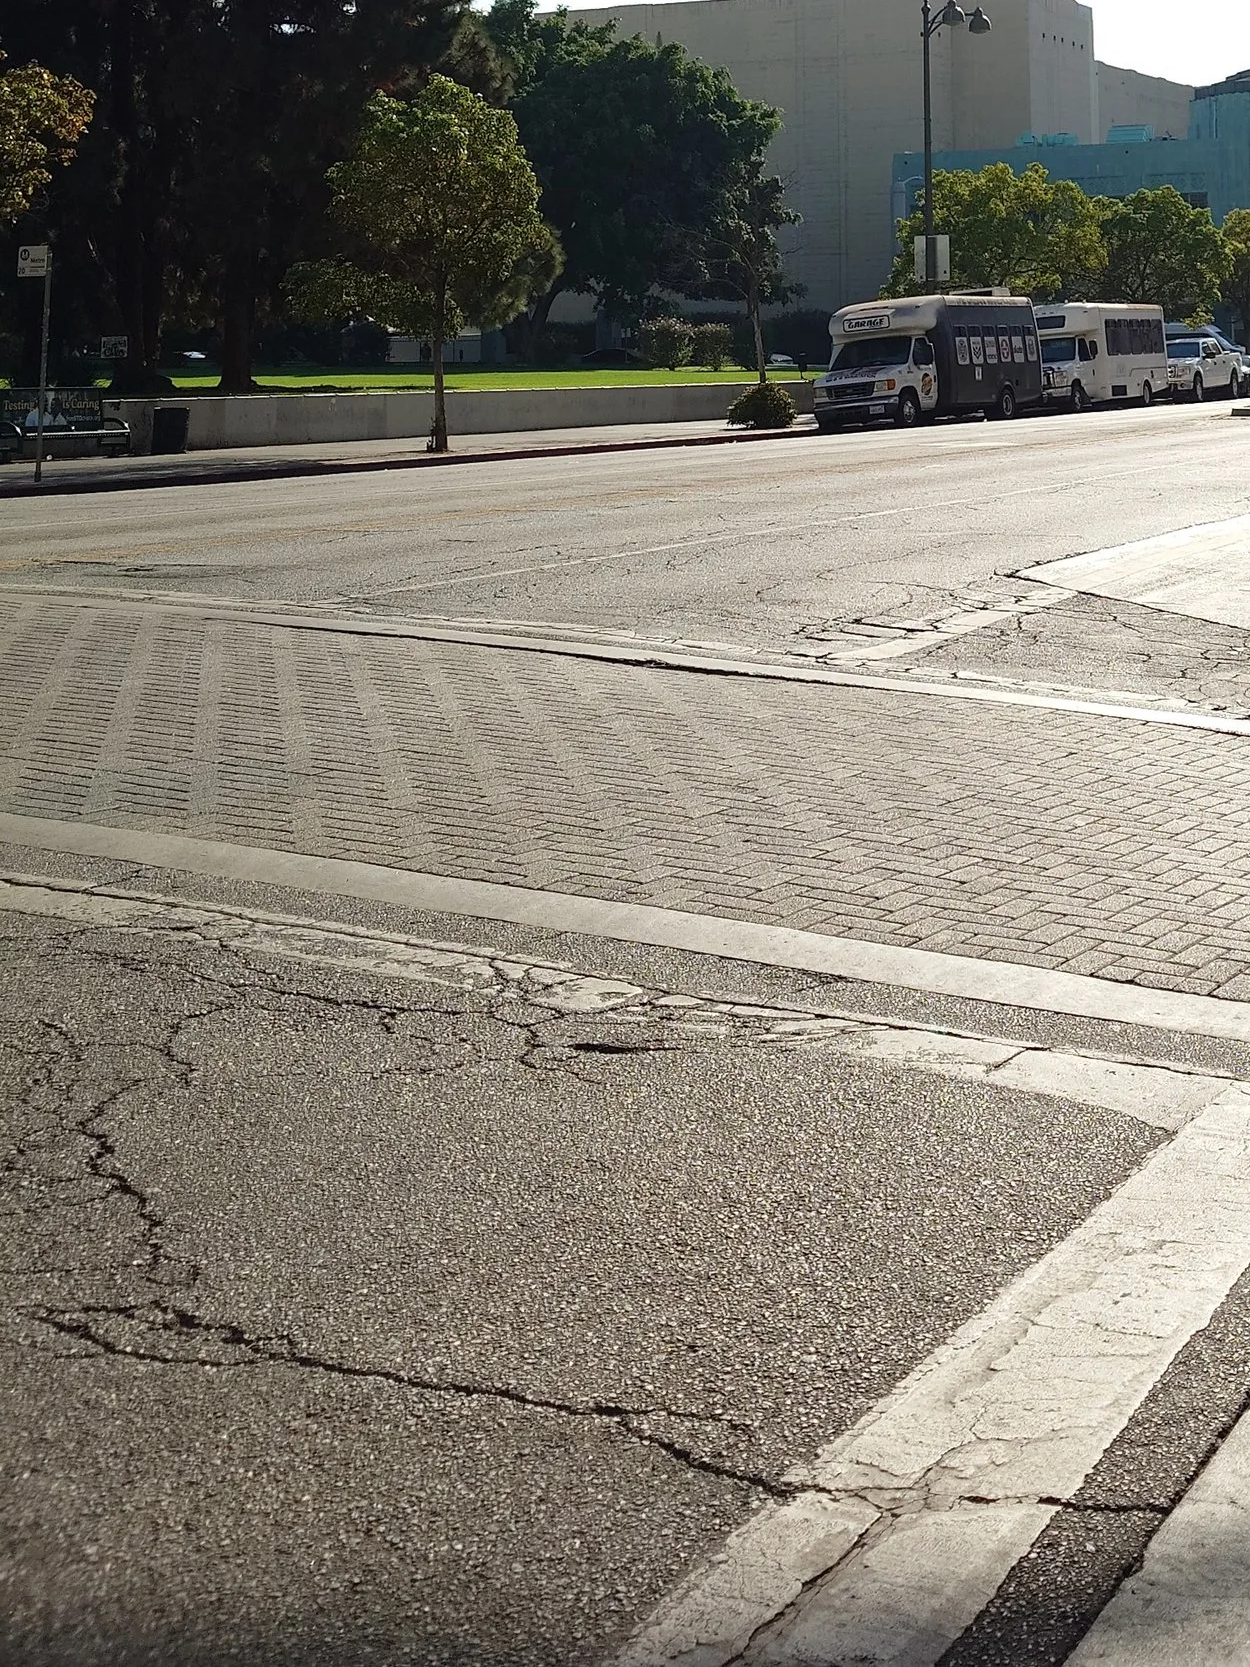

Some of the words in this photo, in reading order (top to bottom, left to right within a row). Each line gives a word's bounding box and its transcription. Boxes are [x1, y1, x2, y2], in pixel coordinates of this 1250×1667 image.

[848, 318, 884, 329] GARAGE
[3, 399, 37, 411] Testing
[62, 399, 70, 409] is
[71, 398, 100, 411] Caring
